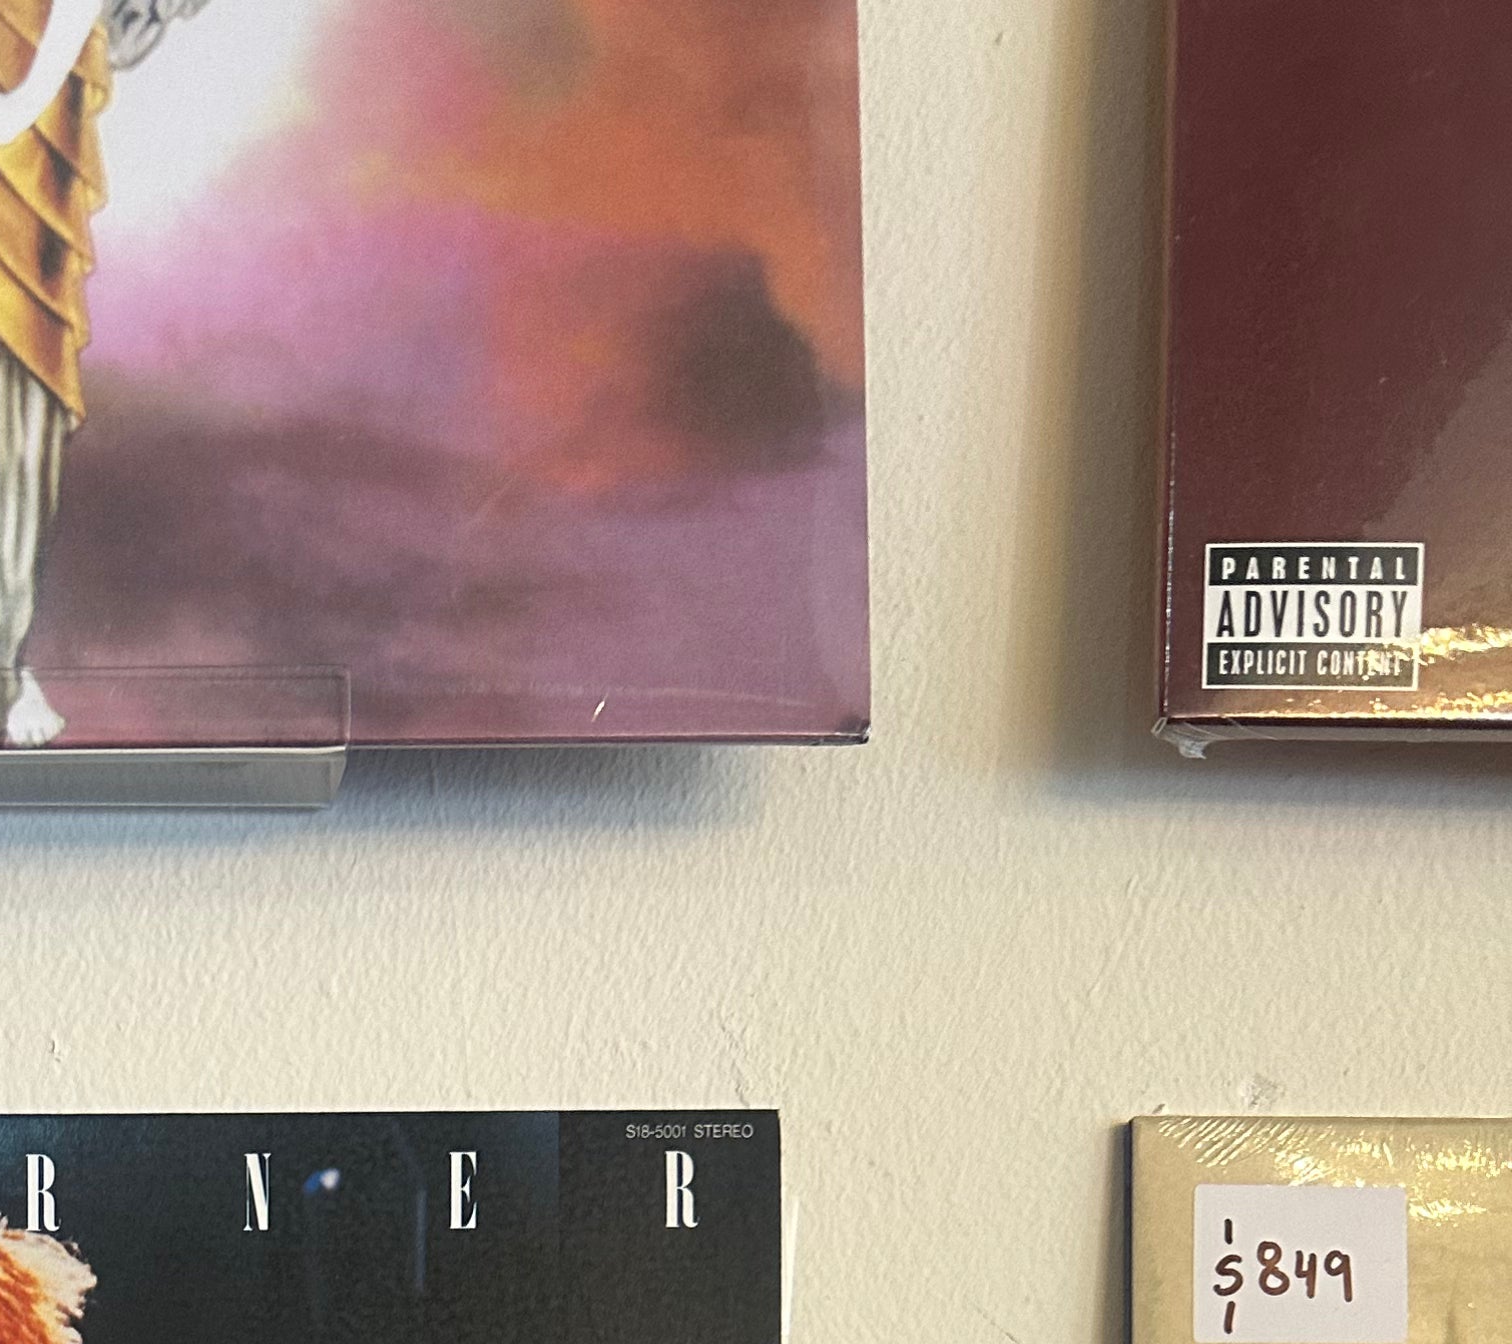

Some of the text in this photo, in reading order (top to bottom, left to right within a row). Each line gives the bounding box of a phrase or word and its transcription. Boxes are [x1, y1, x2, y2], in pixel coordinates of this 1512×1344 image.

[1220, 556, 1407, 581] PARENTAL
[1215, 589, 1408, 639] ADVISORY
[1218, 649, 1308, 676] EXPLICIT
[625, 1123, 754, 1140] S18-5001 STEREO
